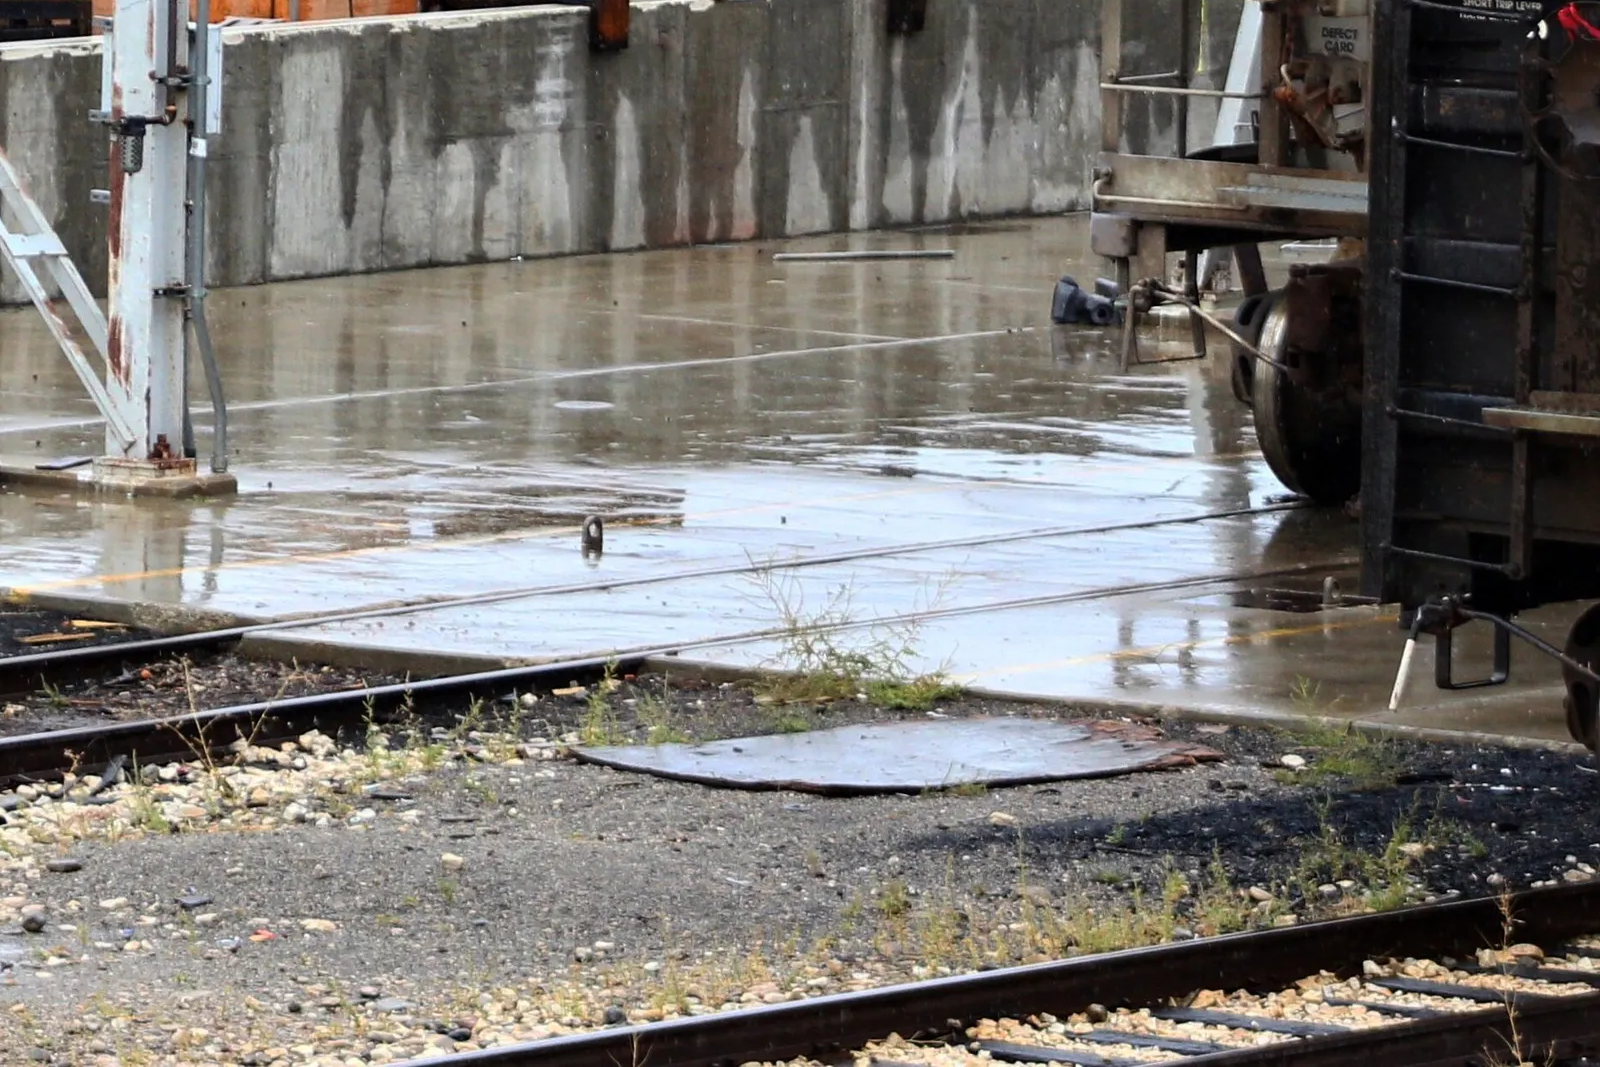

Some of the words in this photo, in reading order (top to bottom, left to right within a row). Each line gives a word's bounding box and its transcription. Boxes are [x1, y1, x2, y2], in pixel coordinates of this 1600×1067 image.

[1495, 0, 1514, 10] TRIP
[1322, 27, 1358, 39] DEFECT
[1324, 40, 1355, 53] CARD
